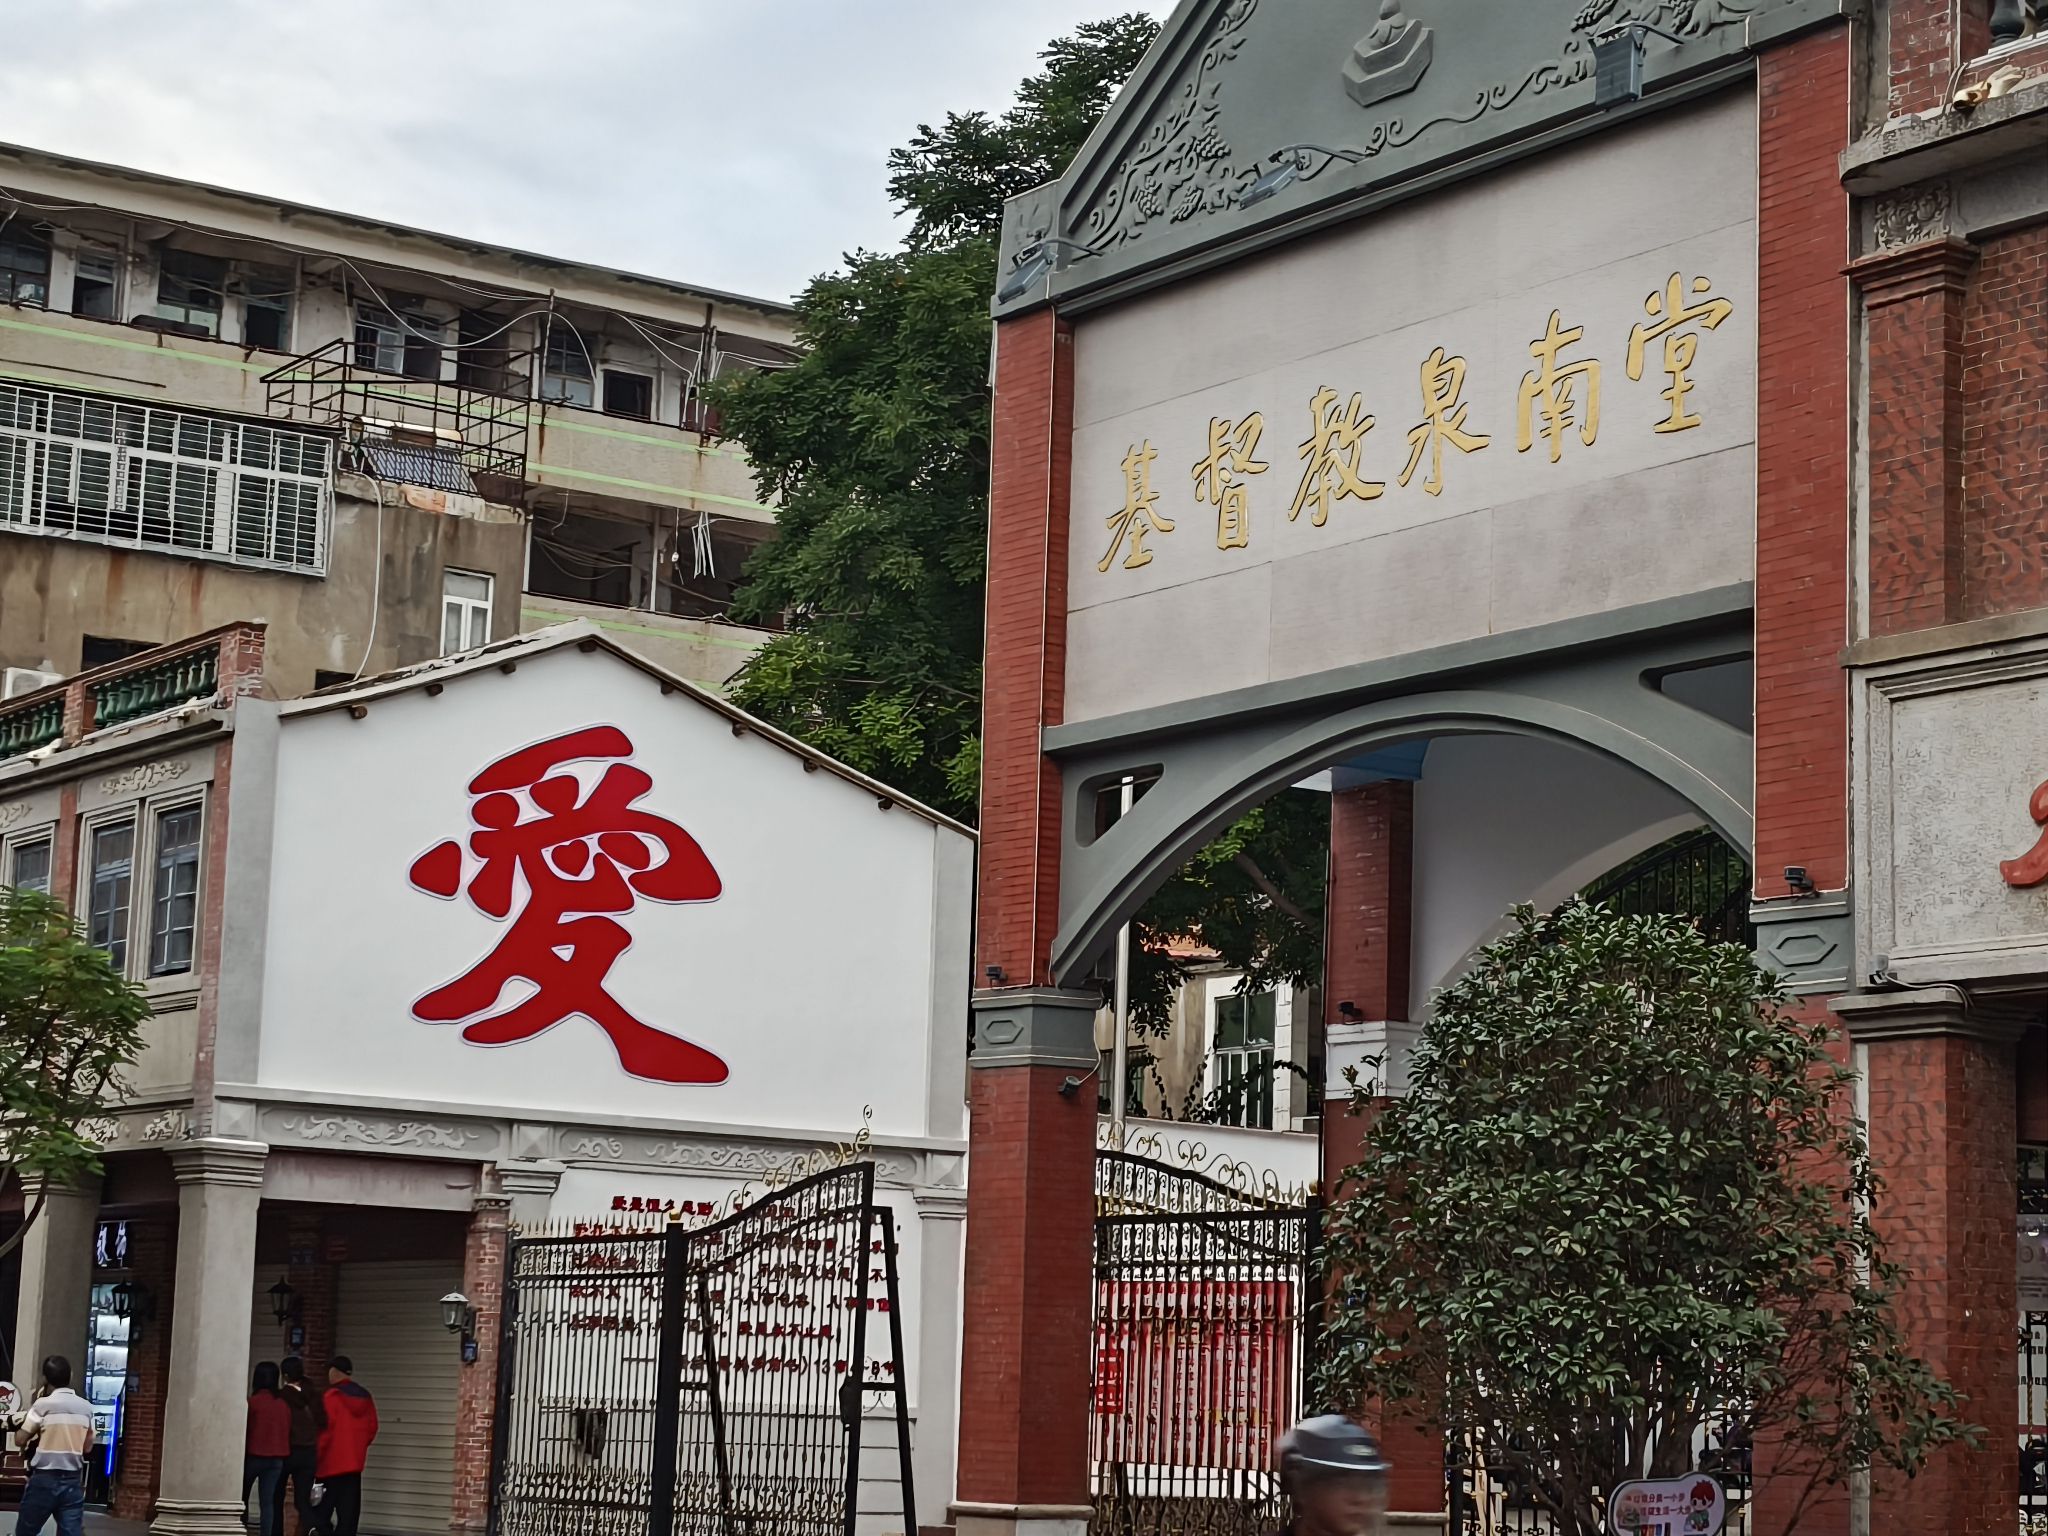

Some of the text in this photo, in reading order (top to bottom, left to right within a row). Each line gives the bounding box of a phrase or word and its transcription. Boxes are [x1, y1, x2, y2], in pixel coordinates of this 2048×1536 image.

[1097, 271, 1733, 573] 基督教泉南堂
